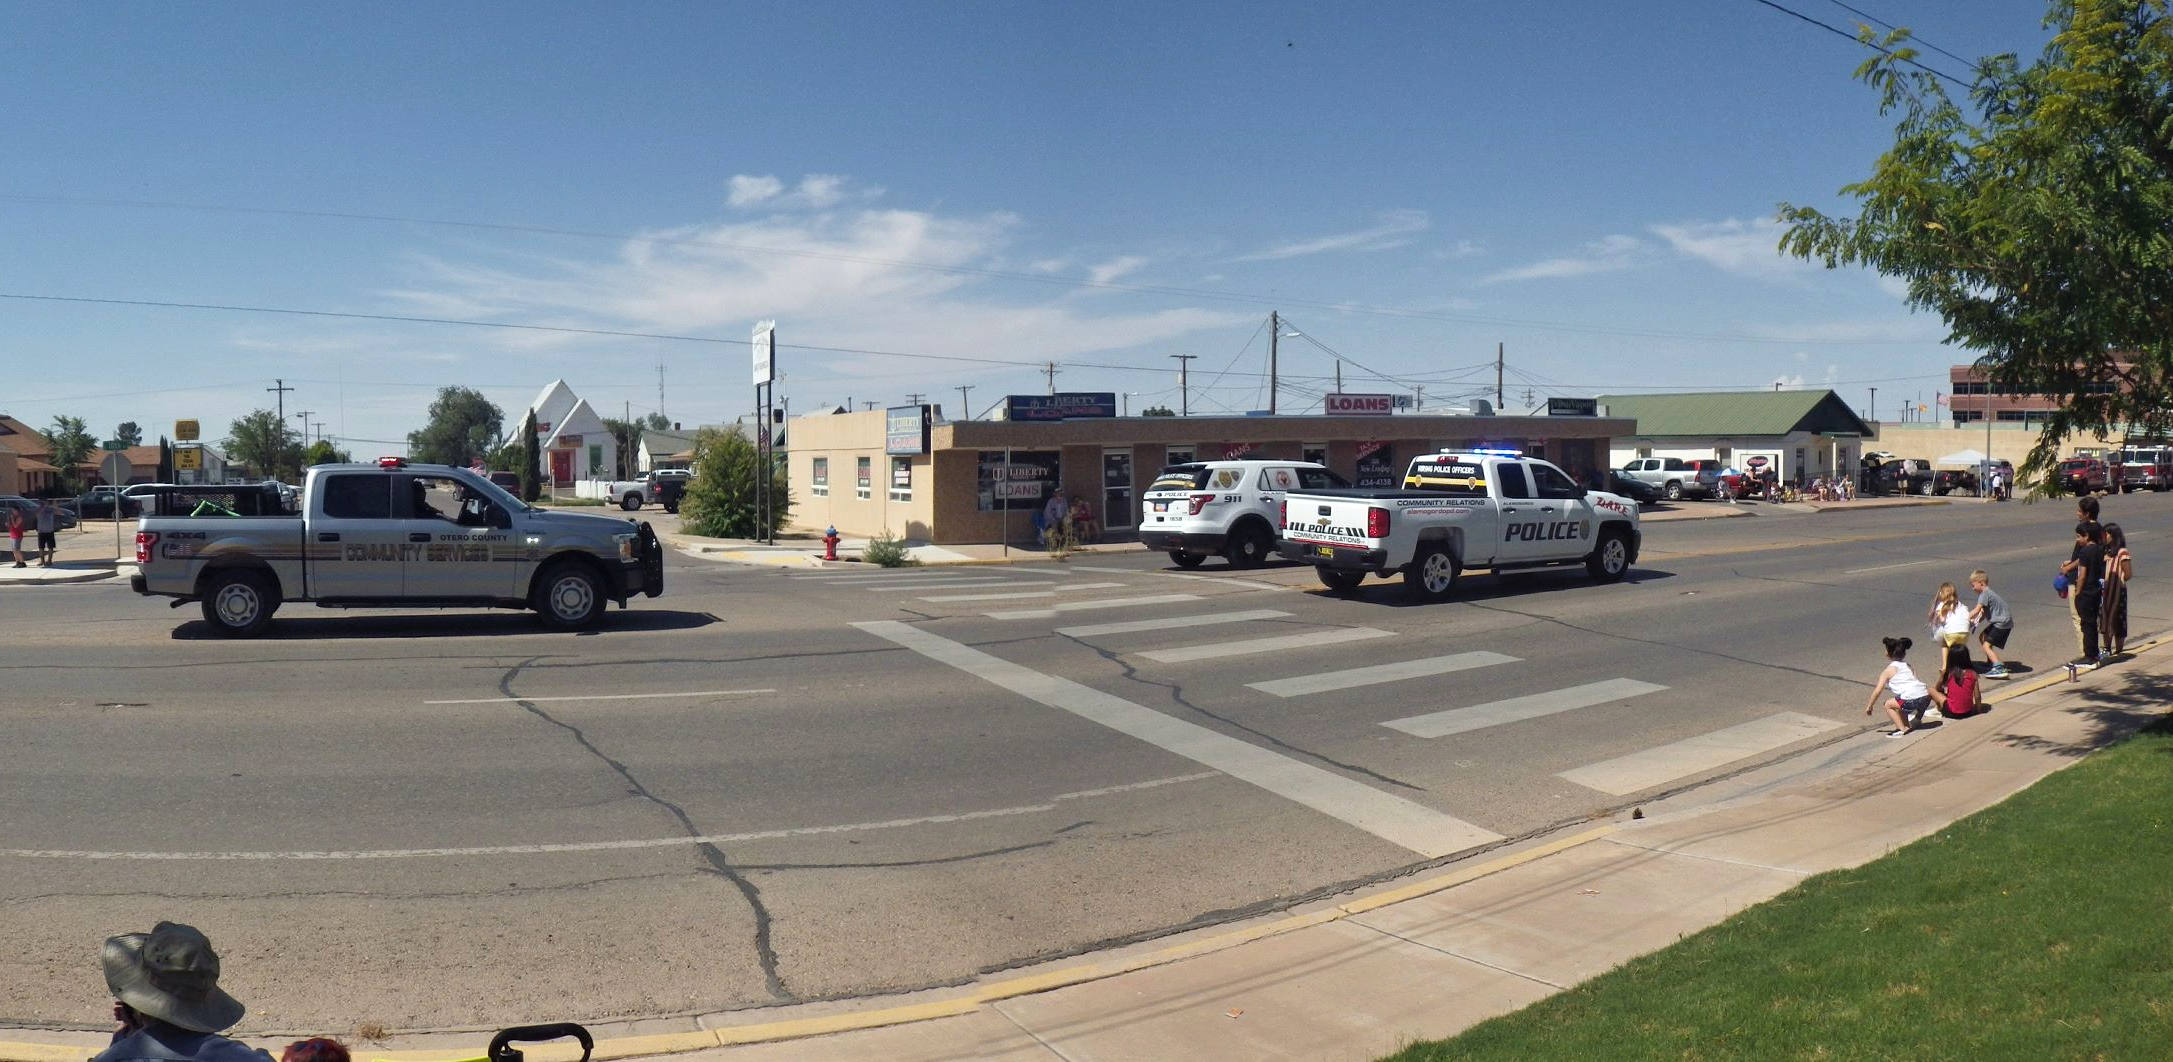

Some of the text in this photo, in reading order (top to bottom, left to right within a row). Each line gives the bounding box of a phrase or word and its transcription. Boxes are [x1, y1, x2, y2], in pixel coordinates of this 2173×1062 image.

[1045, 396, 1096, 408] LIBERTY
[1329, 397, 1389, 411] LOANS
[1009, 466, 1049, 477] LIBERTY
[1433, 465, 1451, 473] POLICE
[1451, 466, 1475, 474] OFFICERS
[998, 482, 1040, 497] LOANS
[1224, 495, 1242, 503] 911
[1397, 499, 1486, 507] COMMUNITY RELATIONS
[1308, 524, 1345, 536] POLICE
[1505, 521, 1580, 542] POLICE
[440, 533, 508, 542] OTERO COUNTY
[1293, 531, 1361, 545] COMMUNITY RELATIONS
[346, 543, 489, 562] COMMUNITY SERVICES
